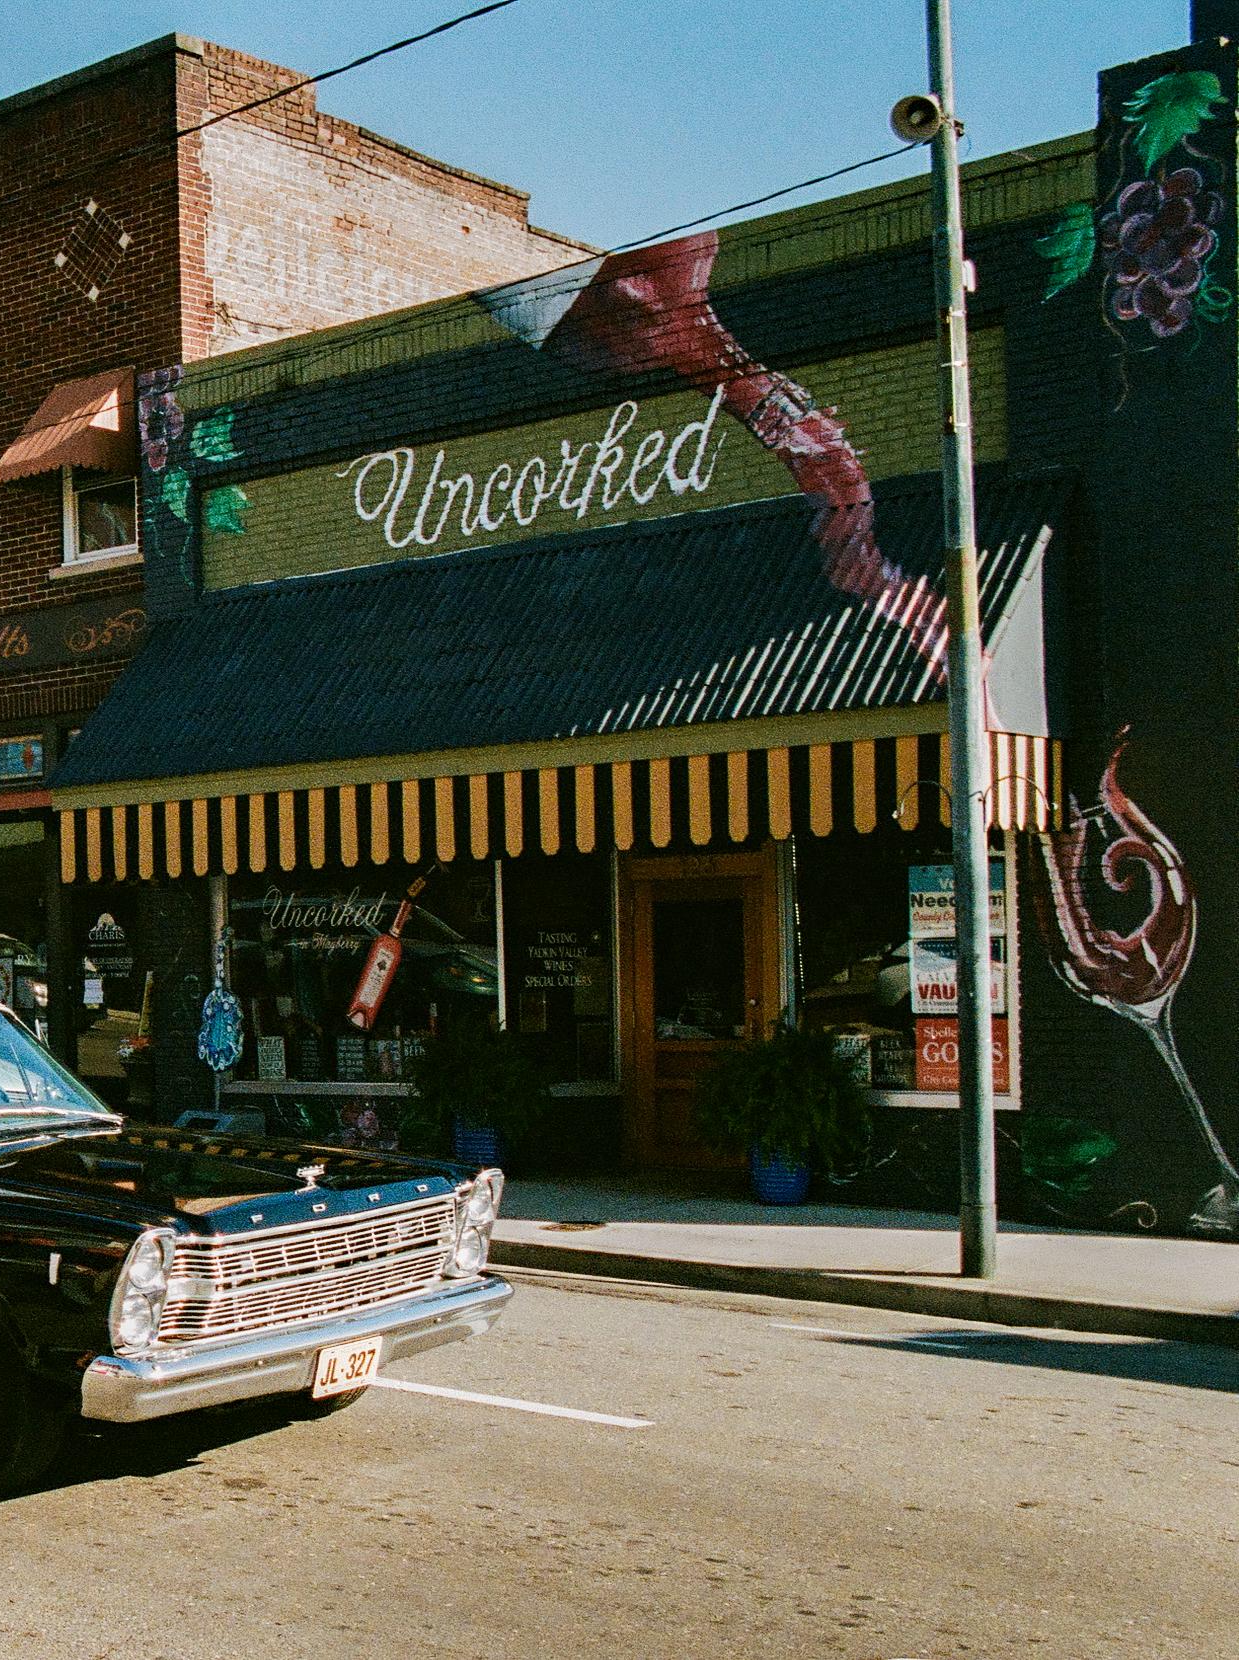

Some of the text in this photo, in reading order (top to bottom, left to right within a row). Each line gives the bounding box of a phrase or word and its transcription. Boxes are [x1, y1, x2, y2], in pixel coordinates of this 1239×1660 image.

[336, 383, 727, 549] Uncorked
[262, 884, 387, 930] Uncorked
[88, 930, 125, 941] CHARIS
[537, 931, 577, 944] TASTING
[543, 960, 574, 971] WINES
[525, 974, 593, 988] SPECIAL ORDERS
